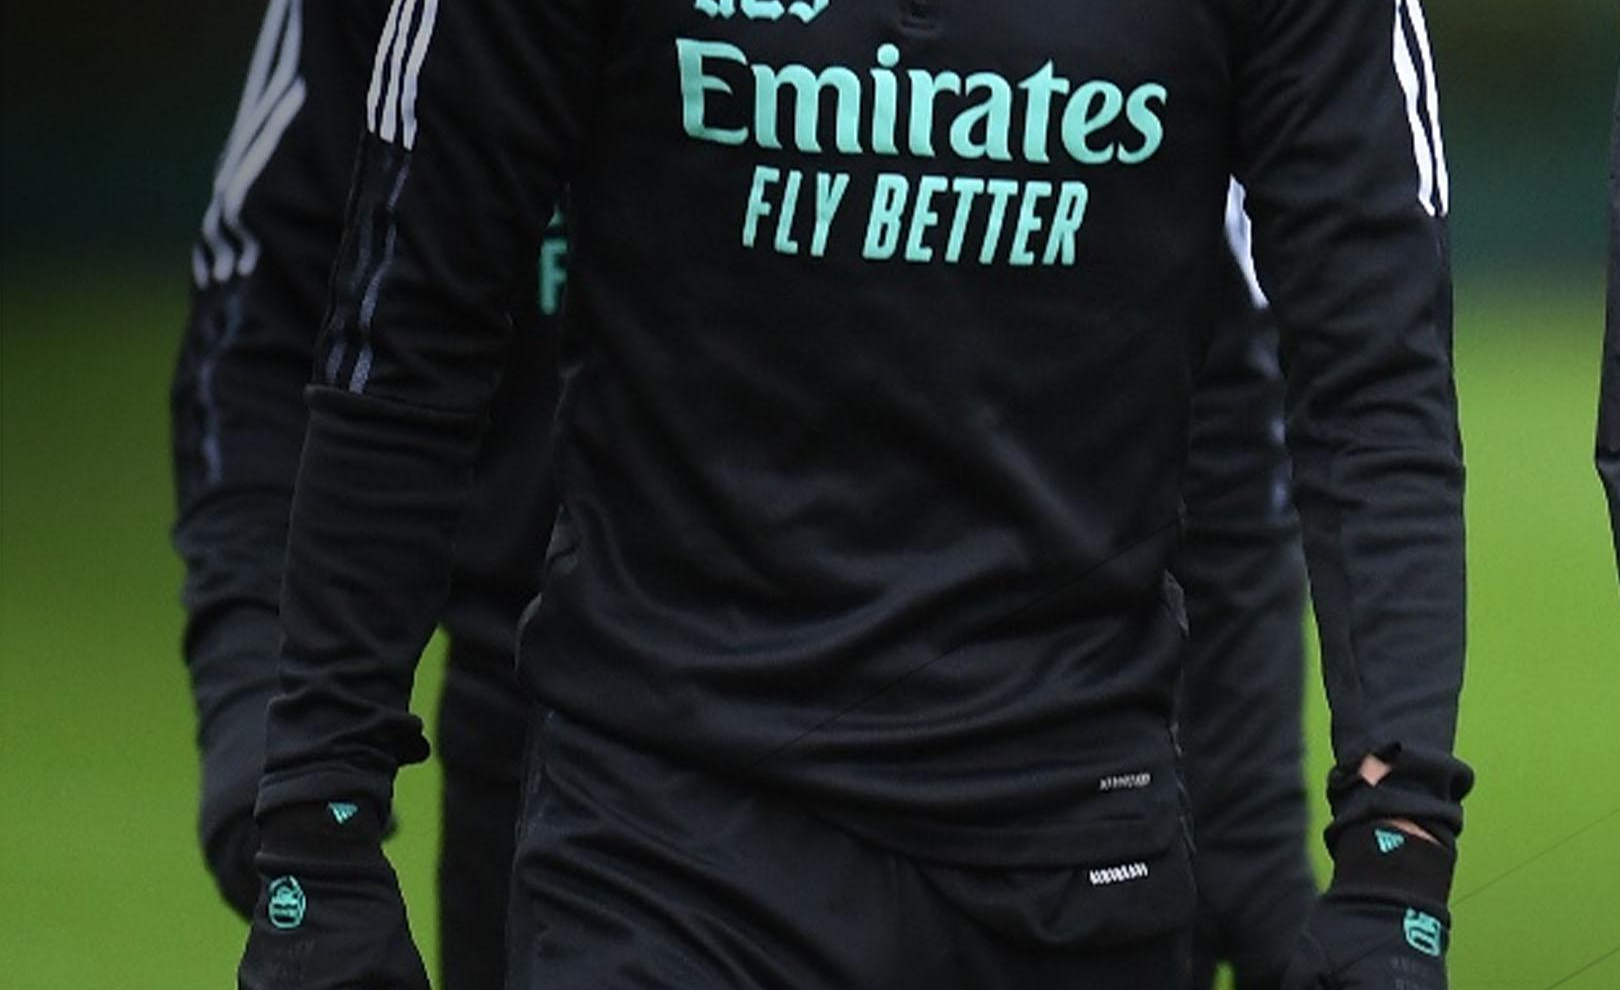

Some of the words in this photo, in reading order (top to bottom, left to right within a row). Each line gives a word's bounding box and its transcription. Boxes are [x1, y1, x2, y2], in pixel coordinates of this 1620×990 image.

[675, 38, 1168, 164] Emirates
[742, 166, 849, 257] FLY
[862, 172, 1088, 266] BETTER
